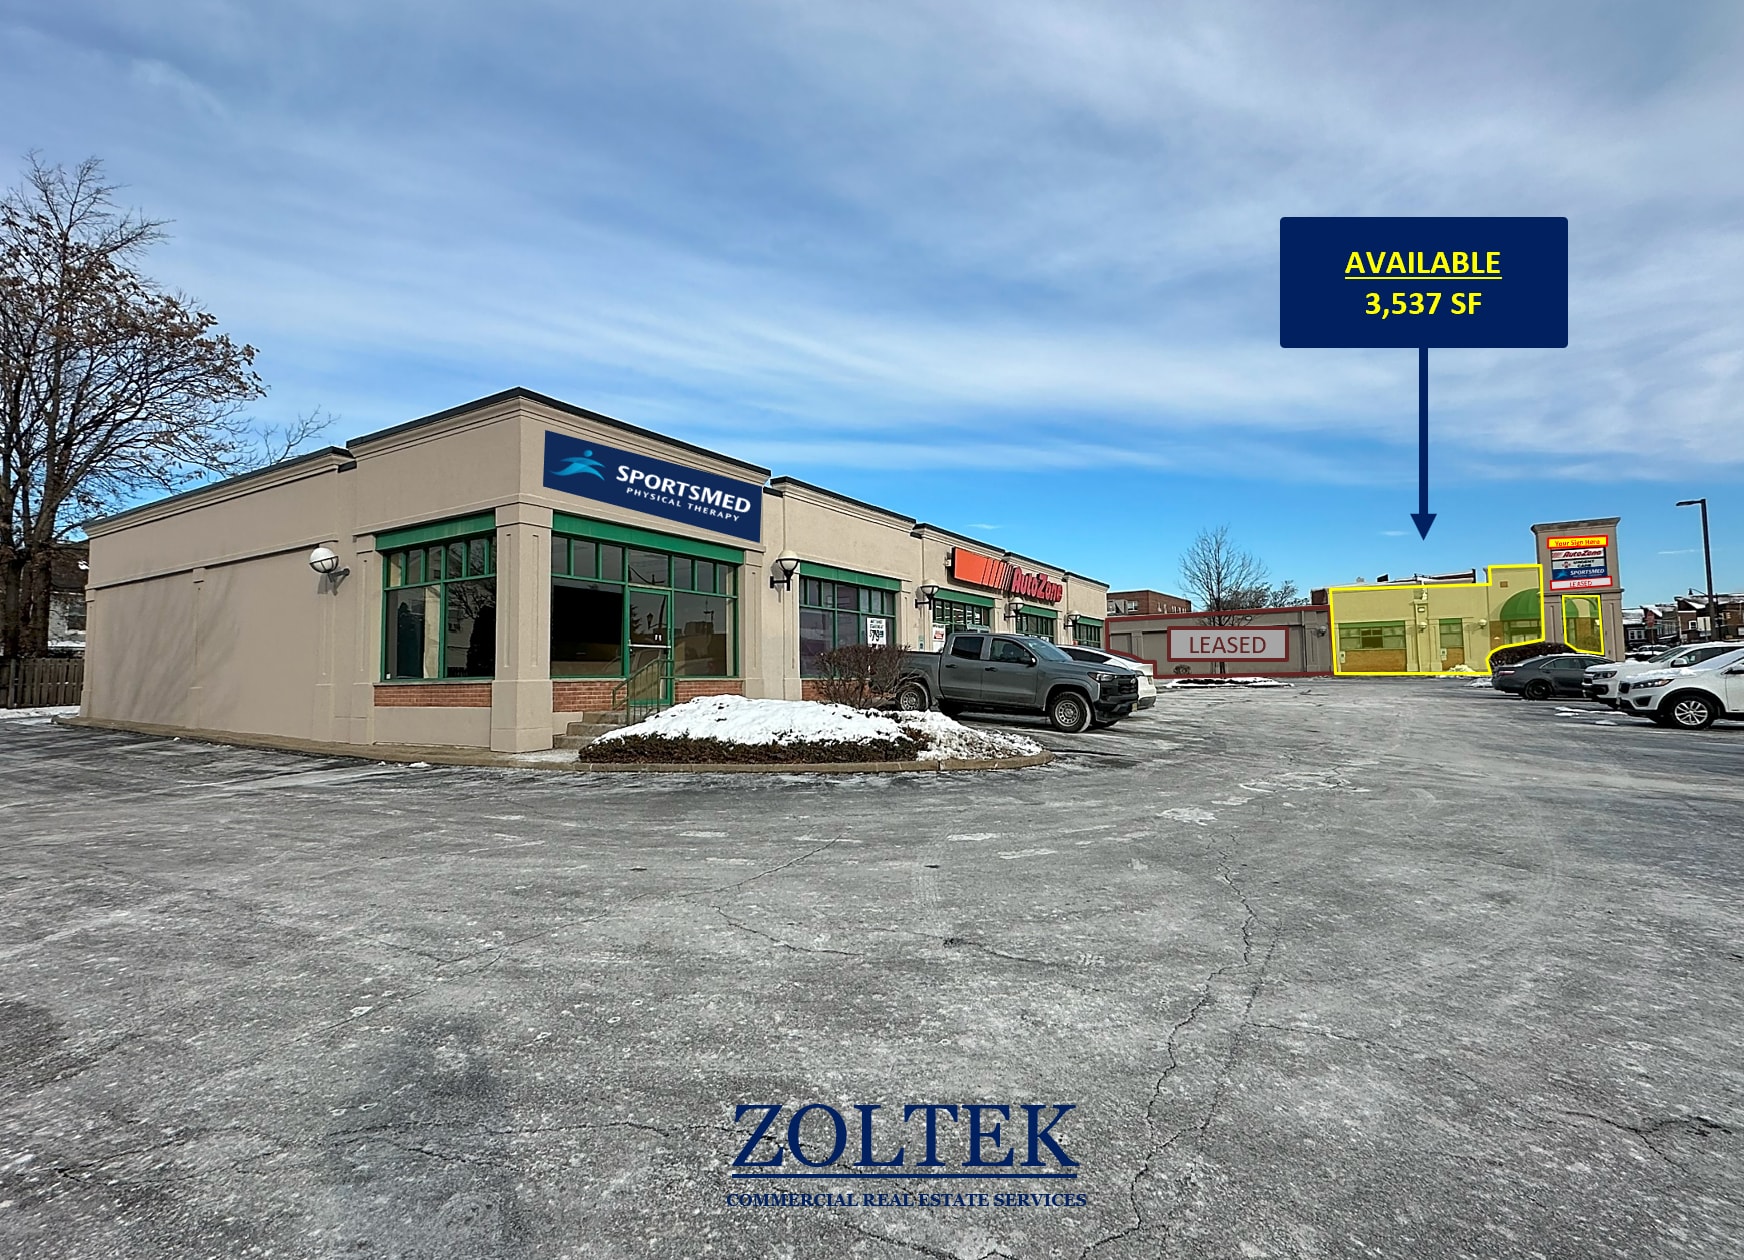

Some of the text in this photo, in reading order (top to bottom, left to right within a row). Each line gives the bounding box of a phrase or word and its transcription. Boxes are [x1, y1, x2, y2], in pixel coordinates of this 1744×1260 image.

[616, 465, 751, 513] SPORTSMED
[626, 487, 740, 522] PHYSICAL THERAPY
[1011, 566, 1063, 602] AutoZone
